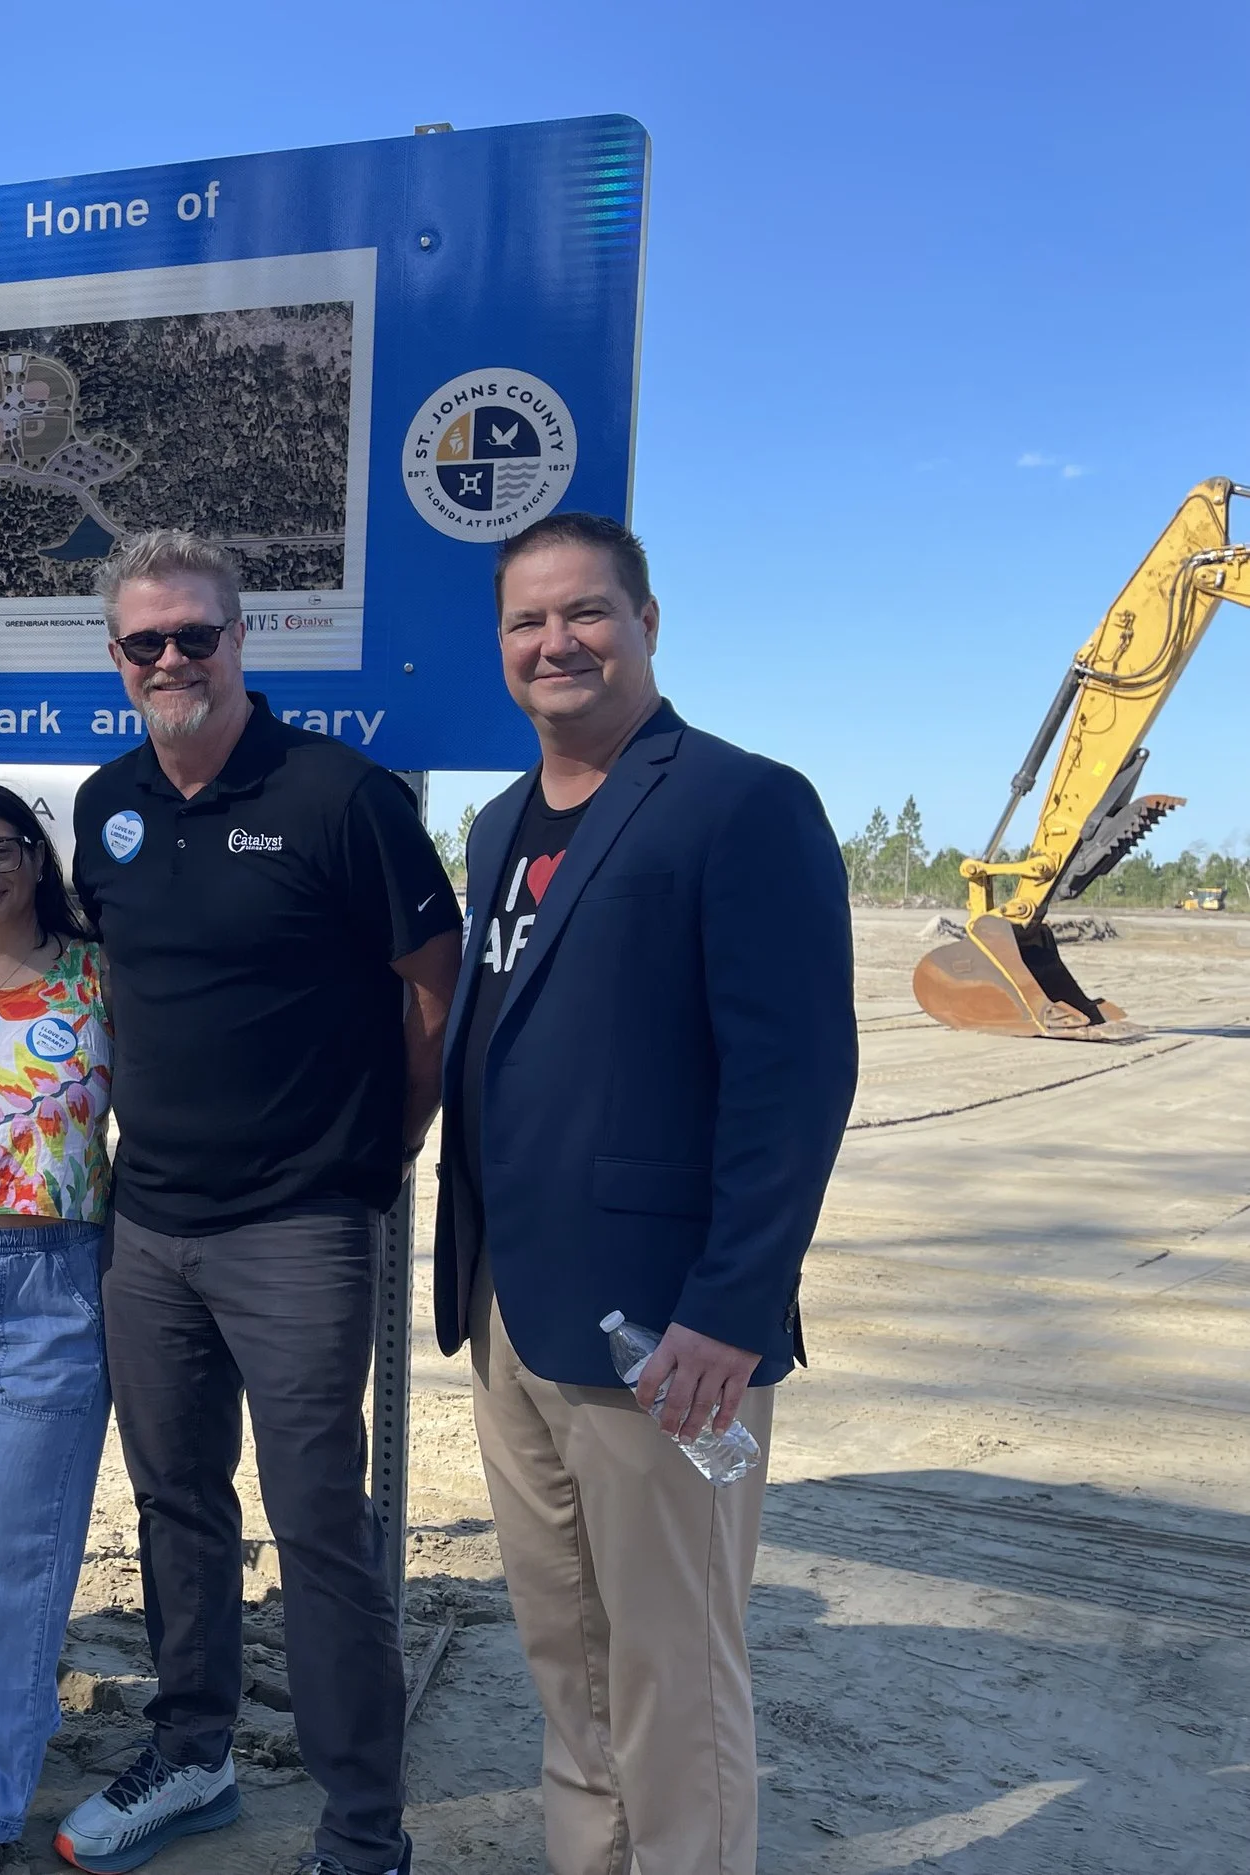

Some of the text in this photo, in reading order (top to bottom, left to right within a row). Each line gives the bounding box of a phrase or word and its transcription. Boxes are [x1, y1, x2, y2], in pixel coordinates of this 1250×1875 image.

[26, 199, 150, 238] Home
[177, 181, 220, 221] of
[416, 384, 564, 458] ST. JOHNS COUNTY
[424, 481, 550, 528] FLORIDA AT FIRST SIGHT
[287, 616, 334, 628] Catalyst
[91, 709, 142, 735] an
[282, 710, 386, 746] rary
[228, 829, 283, 851] Catalyst
[505, 856, 528, 913] I
[44, 1028, 60, 1038] LOVE
